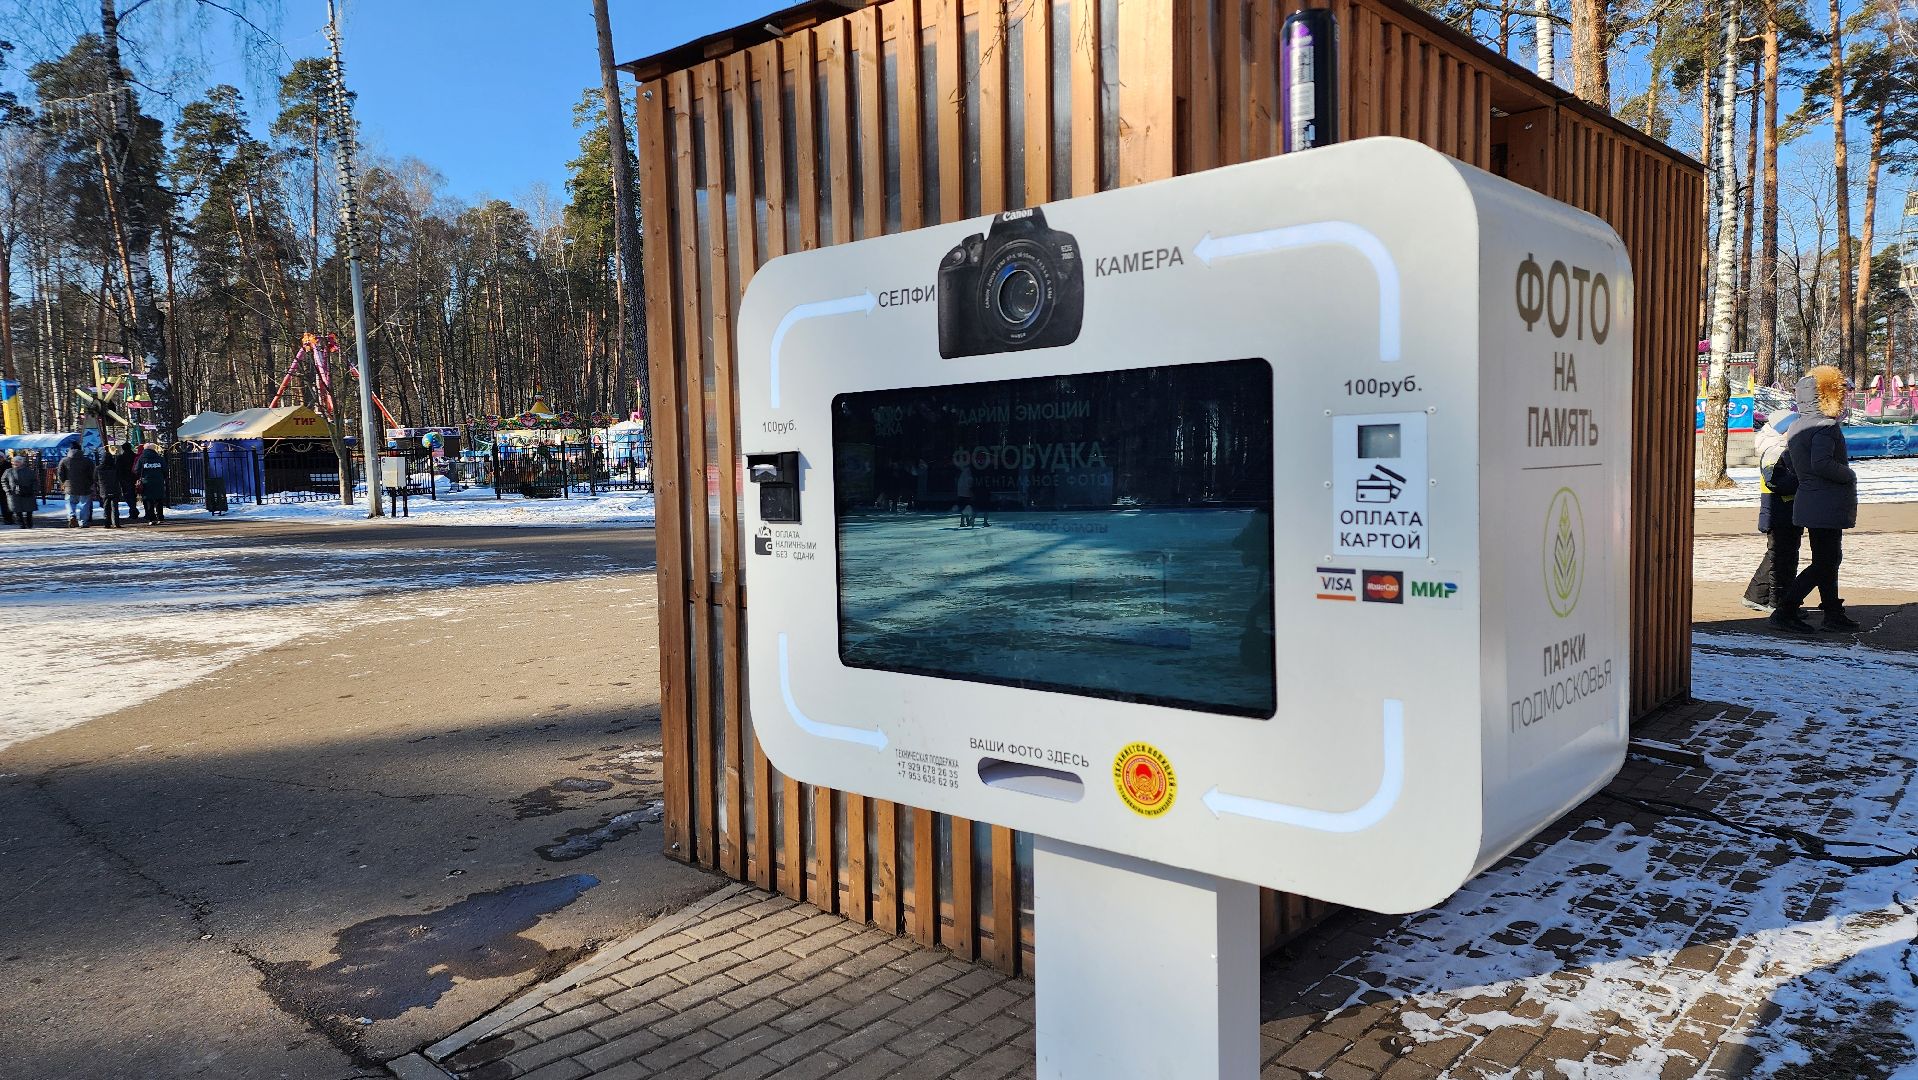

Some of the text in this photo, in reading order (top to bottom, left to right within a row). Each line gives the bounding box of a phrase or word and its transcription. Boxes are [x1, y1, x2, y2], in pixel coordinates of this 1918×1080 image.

[1003, 209, 1033, 221] Canon
[1096, 246, 1185, 277] КАМЕРА
[878, 284, 936, 308] СЕЛФИ
[1516, 253, 1611, 345] ФОТО
[1554, 352, 1577, 392] НА
[1344, 375, 1423, 397] 100руб.
[1015, 400, 1091, 421] ЭМОЦИИ
[293, 417, 316, 426] ТИР
[763, 420, 797, 434] 100руб.
[1528, 407, 1599, 447] ПАМЯТЬ
[952, 440, 1107, 472] ФОТОБУДКА
[1340, 510, 1423, 527] ОПЛАТА
[1340, 530, 1421, 549] КАРТОЙ
[1321, 576, 1353, 591] VISA
[1366, 582, 1399, 592] MasterCard
[1411, 581, 1458, 599] МИР
[1543, 633, 1586, 677] ПАРКИ
[1511, 659, 1612, 734] ПОДМОСКОВЬЯ
[969, 737, 1090, 768] ВАШИ ФОТО ЗДЕСЬ
[949, 779, 959, 789] 95
